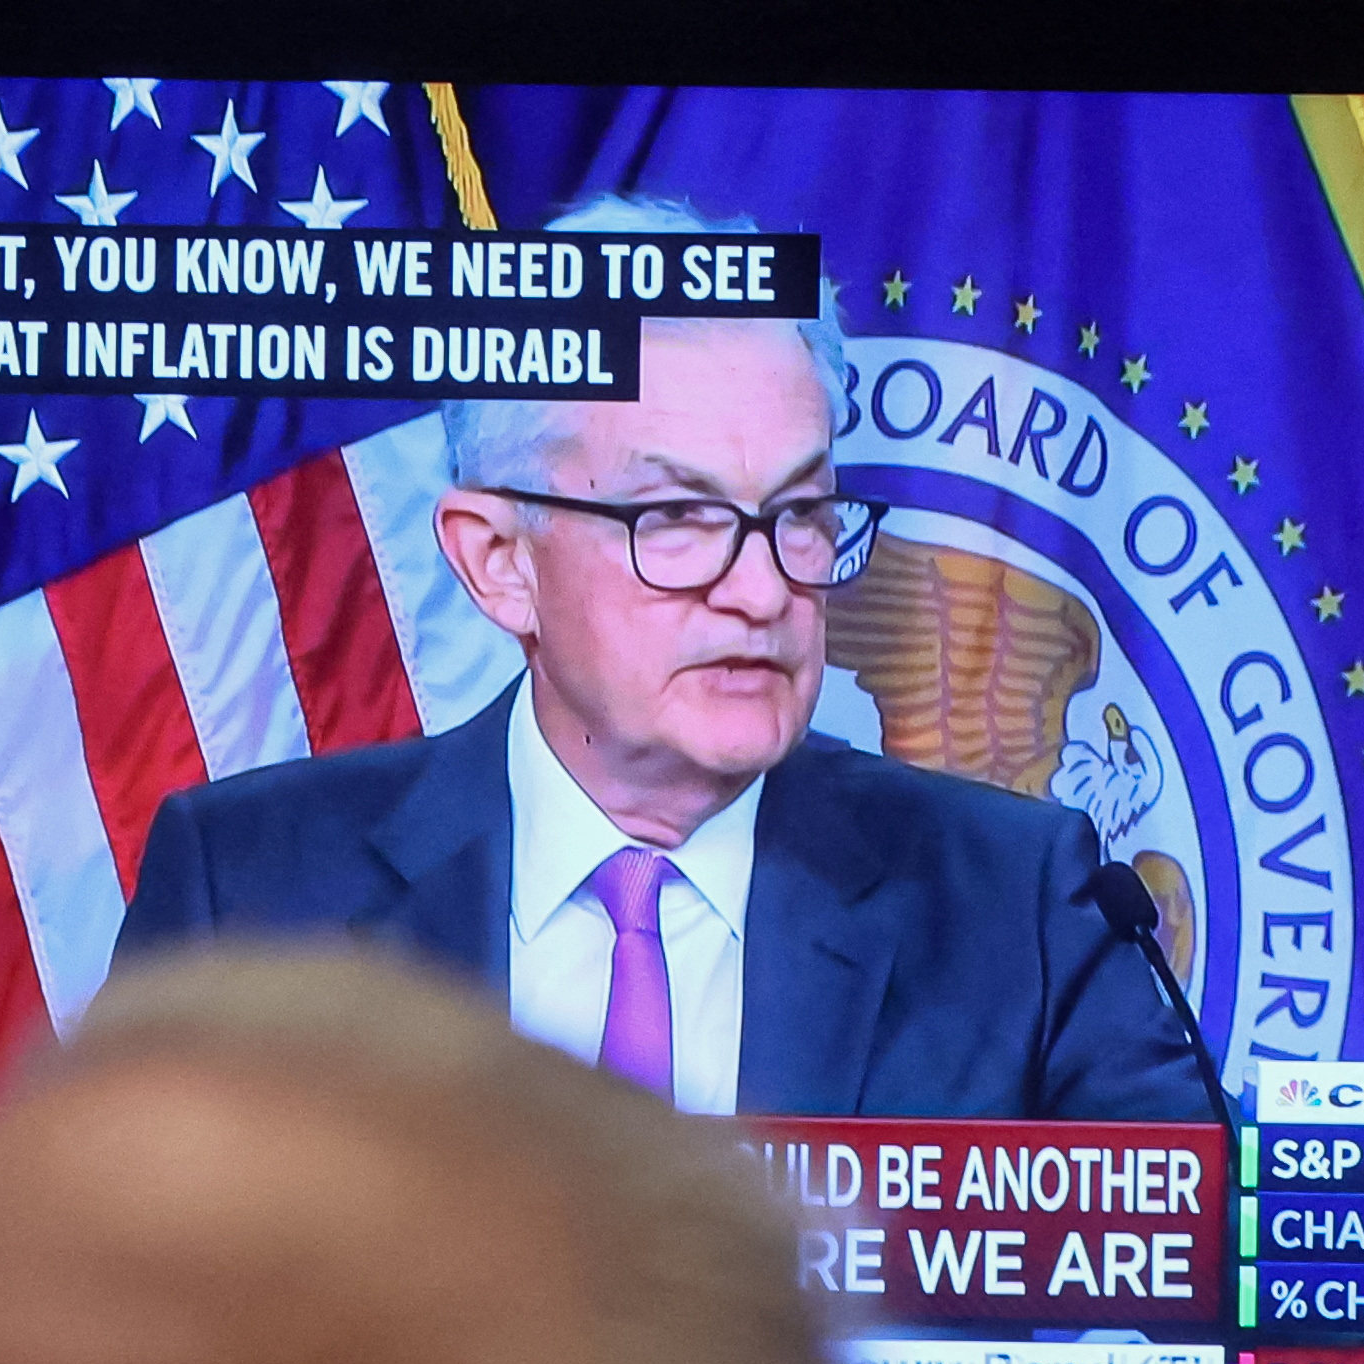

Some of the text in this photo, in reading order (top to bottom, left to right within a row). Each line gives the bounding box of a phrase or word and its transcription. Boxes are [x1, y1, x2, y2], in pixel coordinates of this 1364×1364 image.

[55, 236, 156, 294] YOU
[177, 238, 337, 303] KNOW,
[355, 240, 431, 298] WE
[453, 242, 583, 300] NEED
[601, 244, 664, 300] TO
[682, 245, 776, 301] SEE
[67, 322, 326, 381] INFLATION
[346, 325, 394, 380] IS
[414, 326, 614, 385] DURABL
[1124, 497, 1243, 615] OF
[878, 1144, 942, 1210] BE
[956, 1146, 1201, 1214] ANOTHER
[1271, 1139, 1361, 1180] S&P
[908, 1229, 1026, 1296] WE
[1048, 1232, 1193, 1298] ARE
[1271, 1281, 1307, 1319] %
